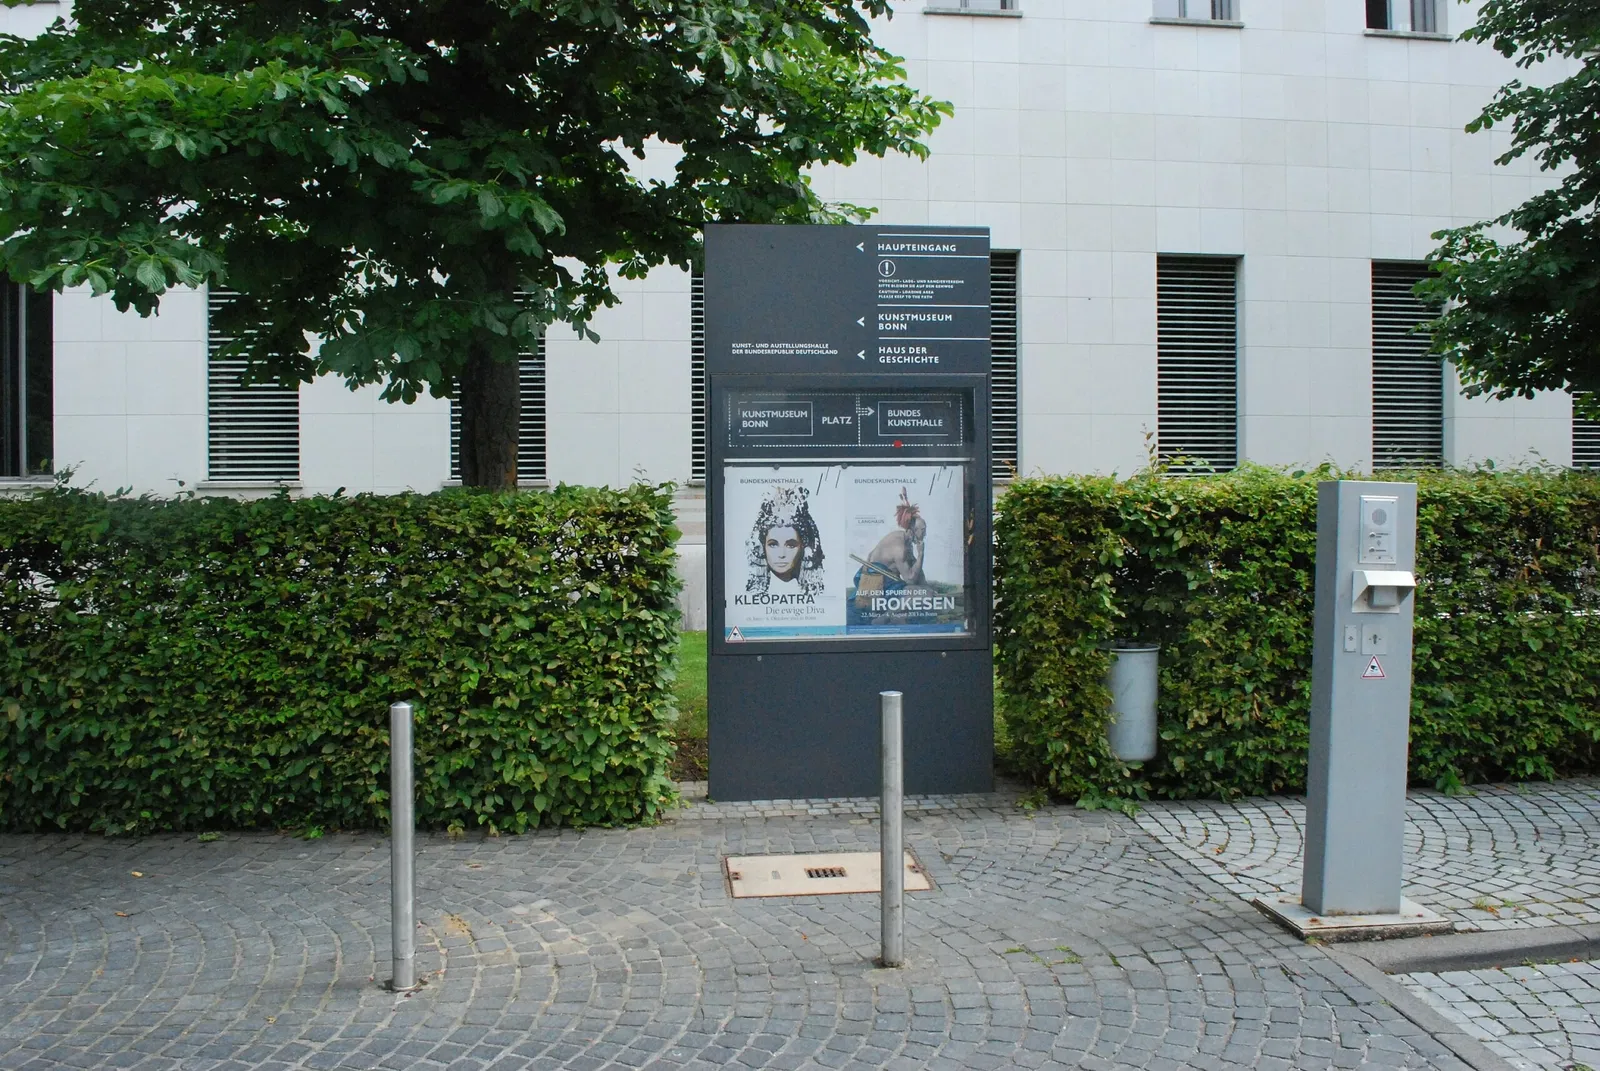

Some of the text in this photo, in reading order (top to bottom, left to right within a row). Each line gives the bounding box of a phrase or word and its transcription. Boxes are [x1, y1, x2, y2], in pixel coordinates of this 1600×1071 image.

[877, 243, 957, 252] HAUPTEINGANG
[878, 313, 953, 322] KUNSTMUSEUM
[878, 323, 908, 331] BONN
[878, 346, 927, 355] HAUS DER
[878, 355, 940, 364] GESCHICHTE
[742, 410, 808, 419] KUNSTMUSEUM
[887, 409, 921, 417] BUNDES
[742, 420, 769, 428] BONN
[821, 416, 852, 425] PLATZ
[887, 419, 943, 427] KUNSTHALLE
[734, 594, 815, 605] KLEOPATRA
[871, 596, 955, 611] IROKESEN
[765, 606, 825, 617] Die ewige Diva
